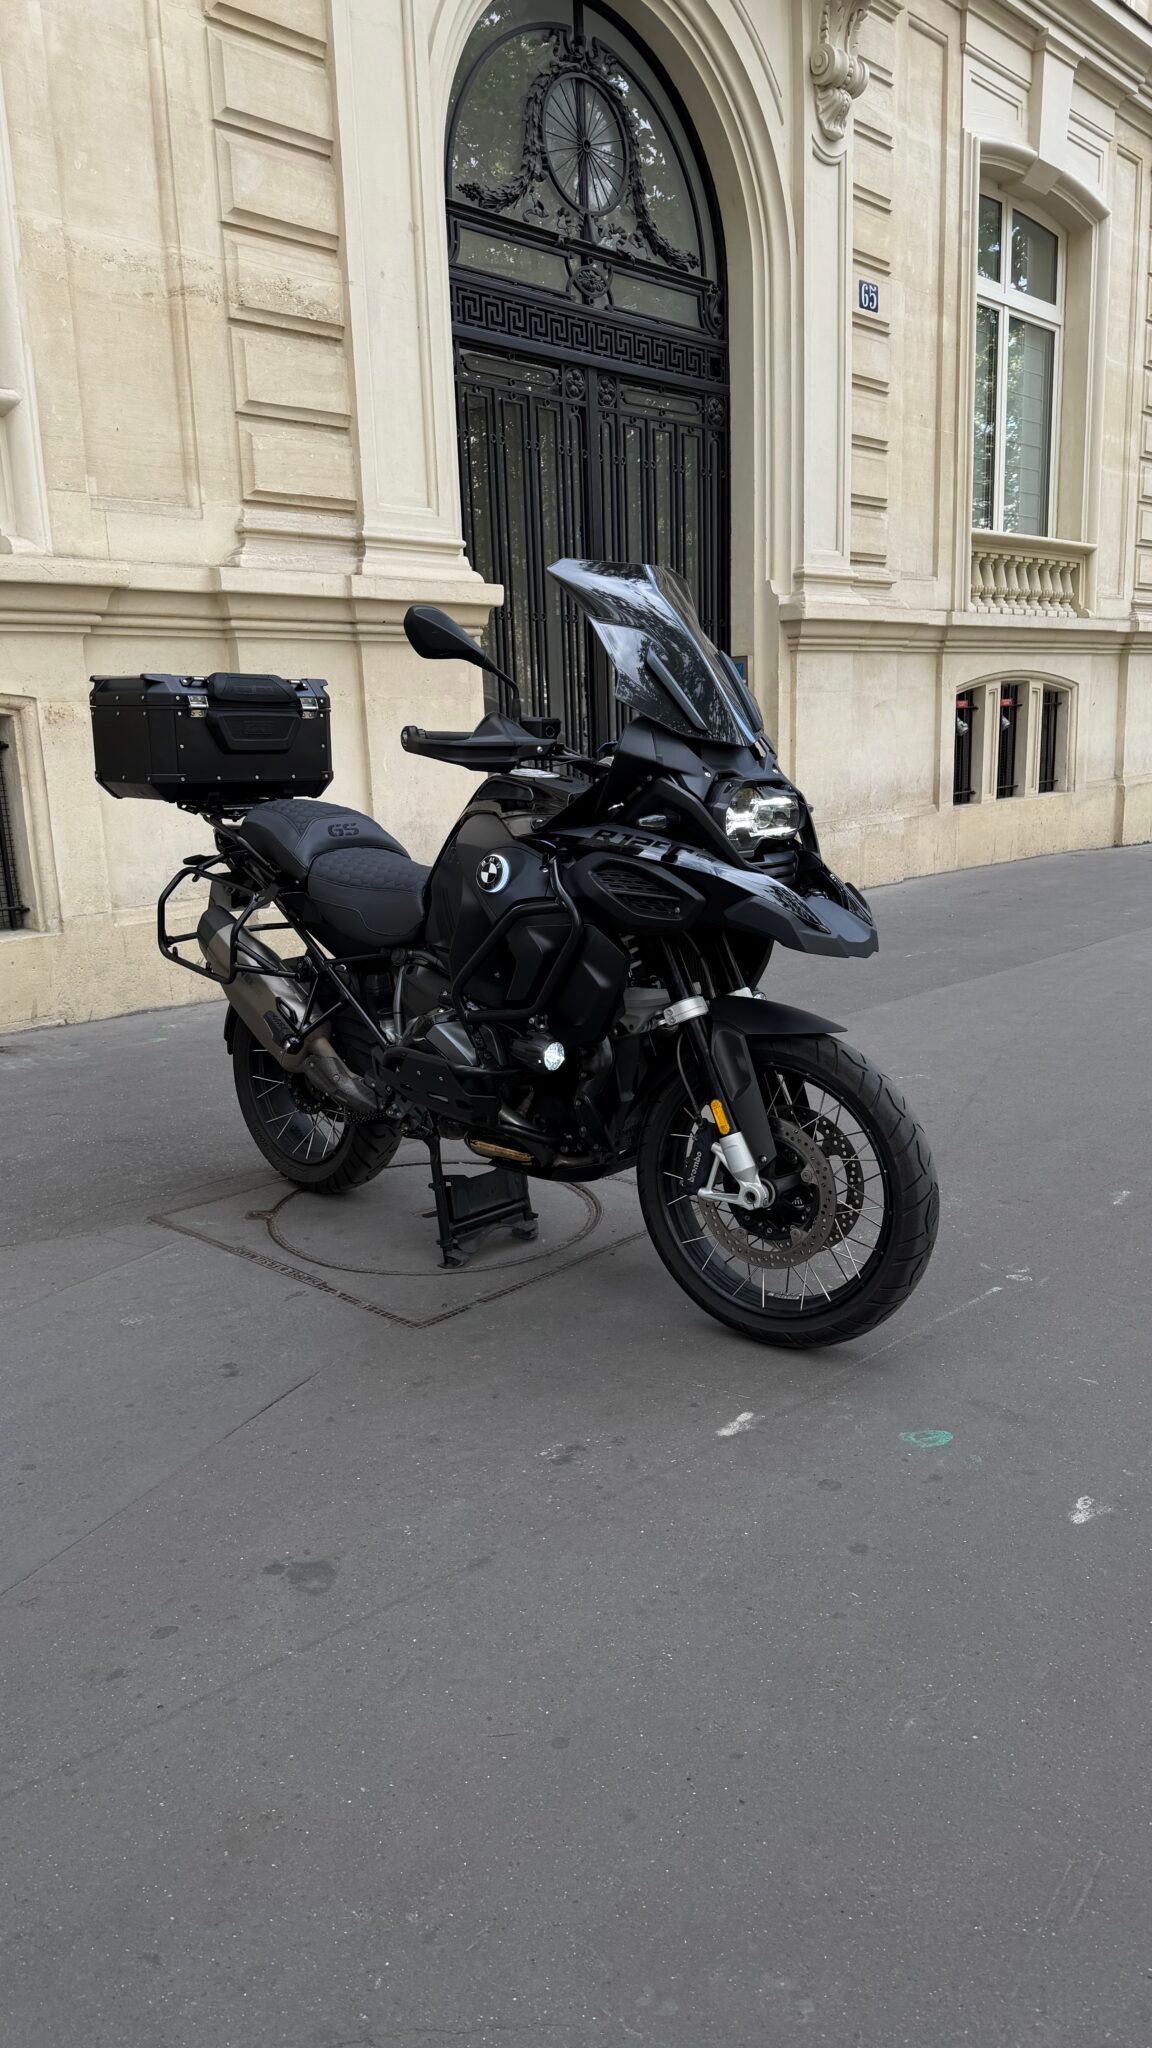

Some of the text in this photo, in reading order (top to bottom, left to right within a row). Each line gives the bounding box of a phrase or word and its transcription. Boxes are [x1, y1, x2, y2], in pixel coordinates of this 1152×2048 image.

[861, 283, 877, 309] 65
[328, 823, 359, 837] GS
[687, 1151, 702, 1183] brembo
